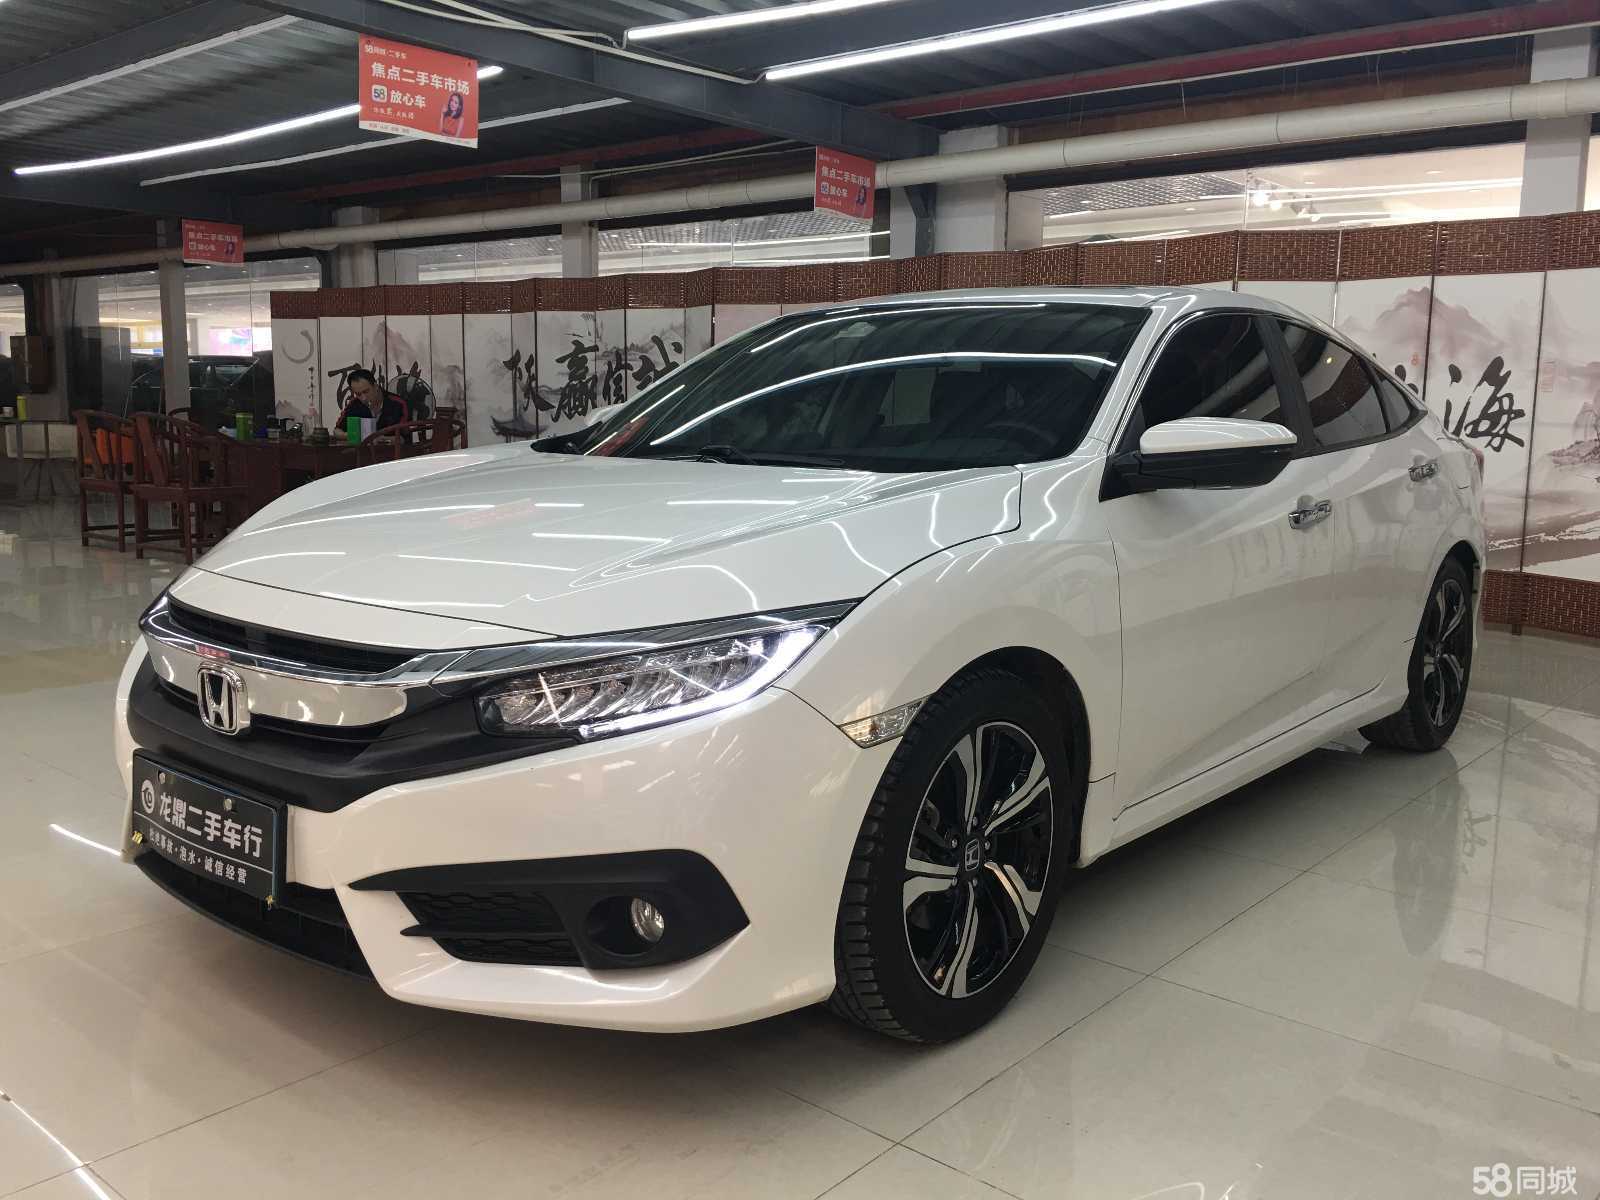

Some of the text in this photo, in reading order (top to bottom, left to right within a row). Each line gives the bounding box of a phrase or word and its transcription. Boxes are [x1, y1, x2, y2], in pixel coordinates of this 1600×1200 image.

[371, 62, 470, 95] 焦点二手车市场
[390, 89, 426, 108] 放心车
[159, 791, 263, 858] 龙鼎二手车行
